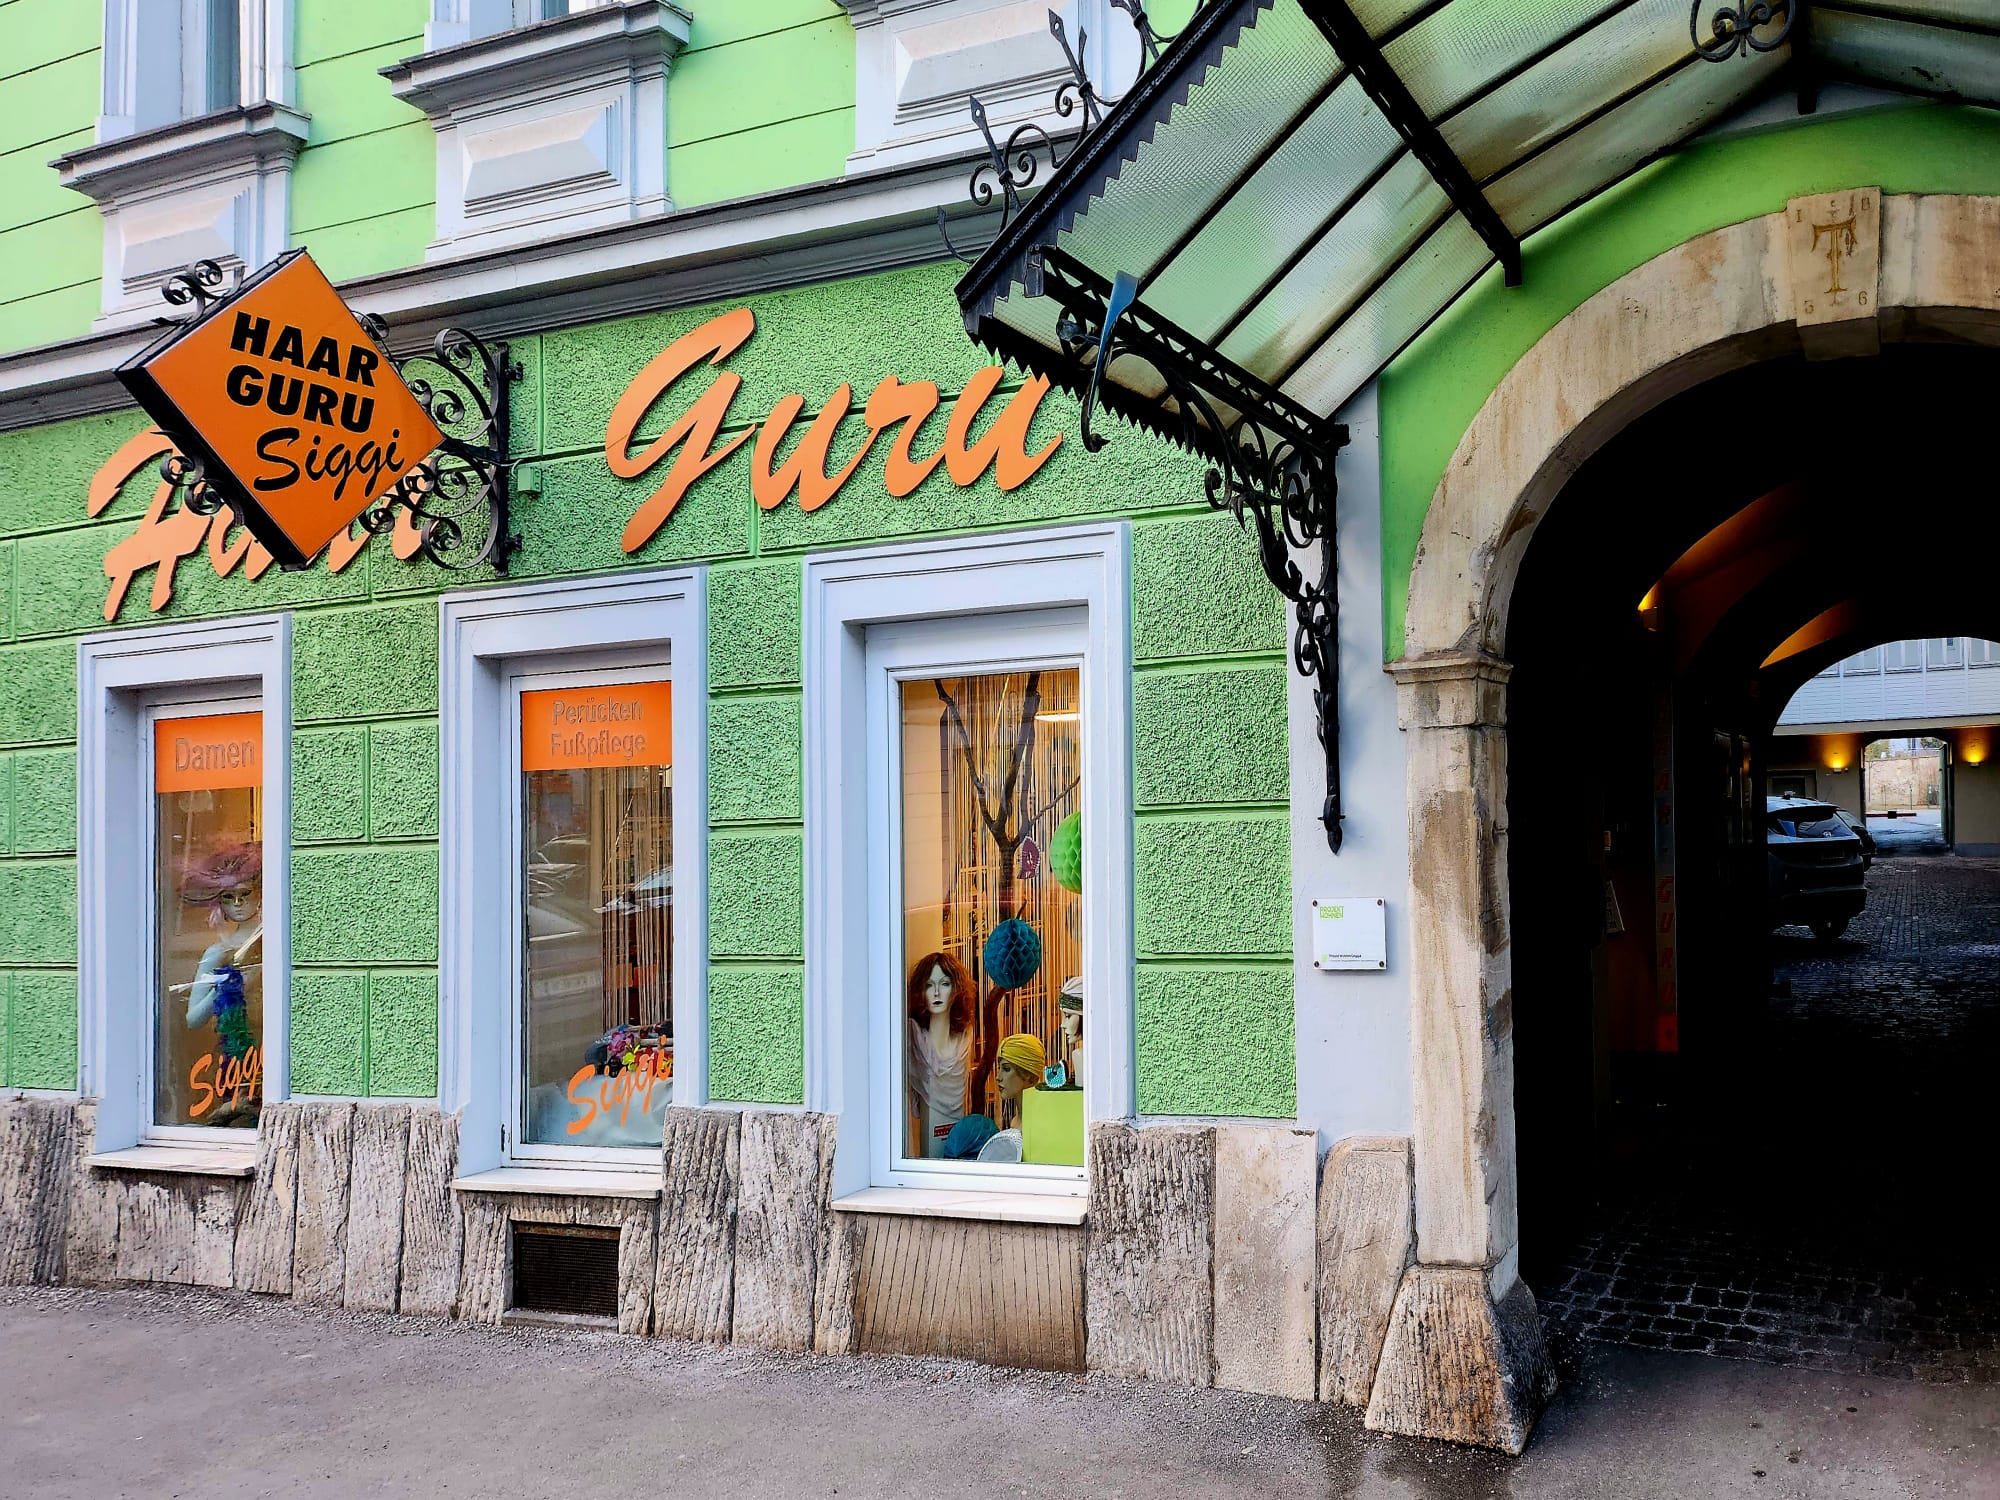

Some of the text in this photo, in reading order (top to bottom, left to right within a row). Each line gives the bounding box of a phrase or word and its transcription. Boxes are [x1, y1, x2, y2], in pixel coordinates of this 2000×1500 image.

[229, 311, 379, 388] HAAR
[225, 364, 375, 434] GURU
[605, 307, 1063, 553] Guru
[253, 427, 405, 501] Siggi
[551, 729, 646, 762] Fußpflege
[552, 697, 643, 726] Perücken
[175, 737, 255, 772] Damen
[566, 1034, 671, 1136] Siggi
